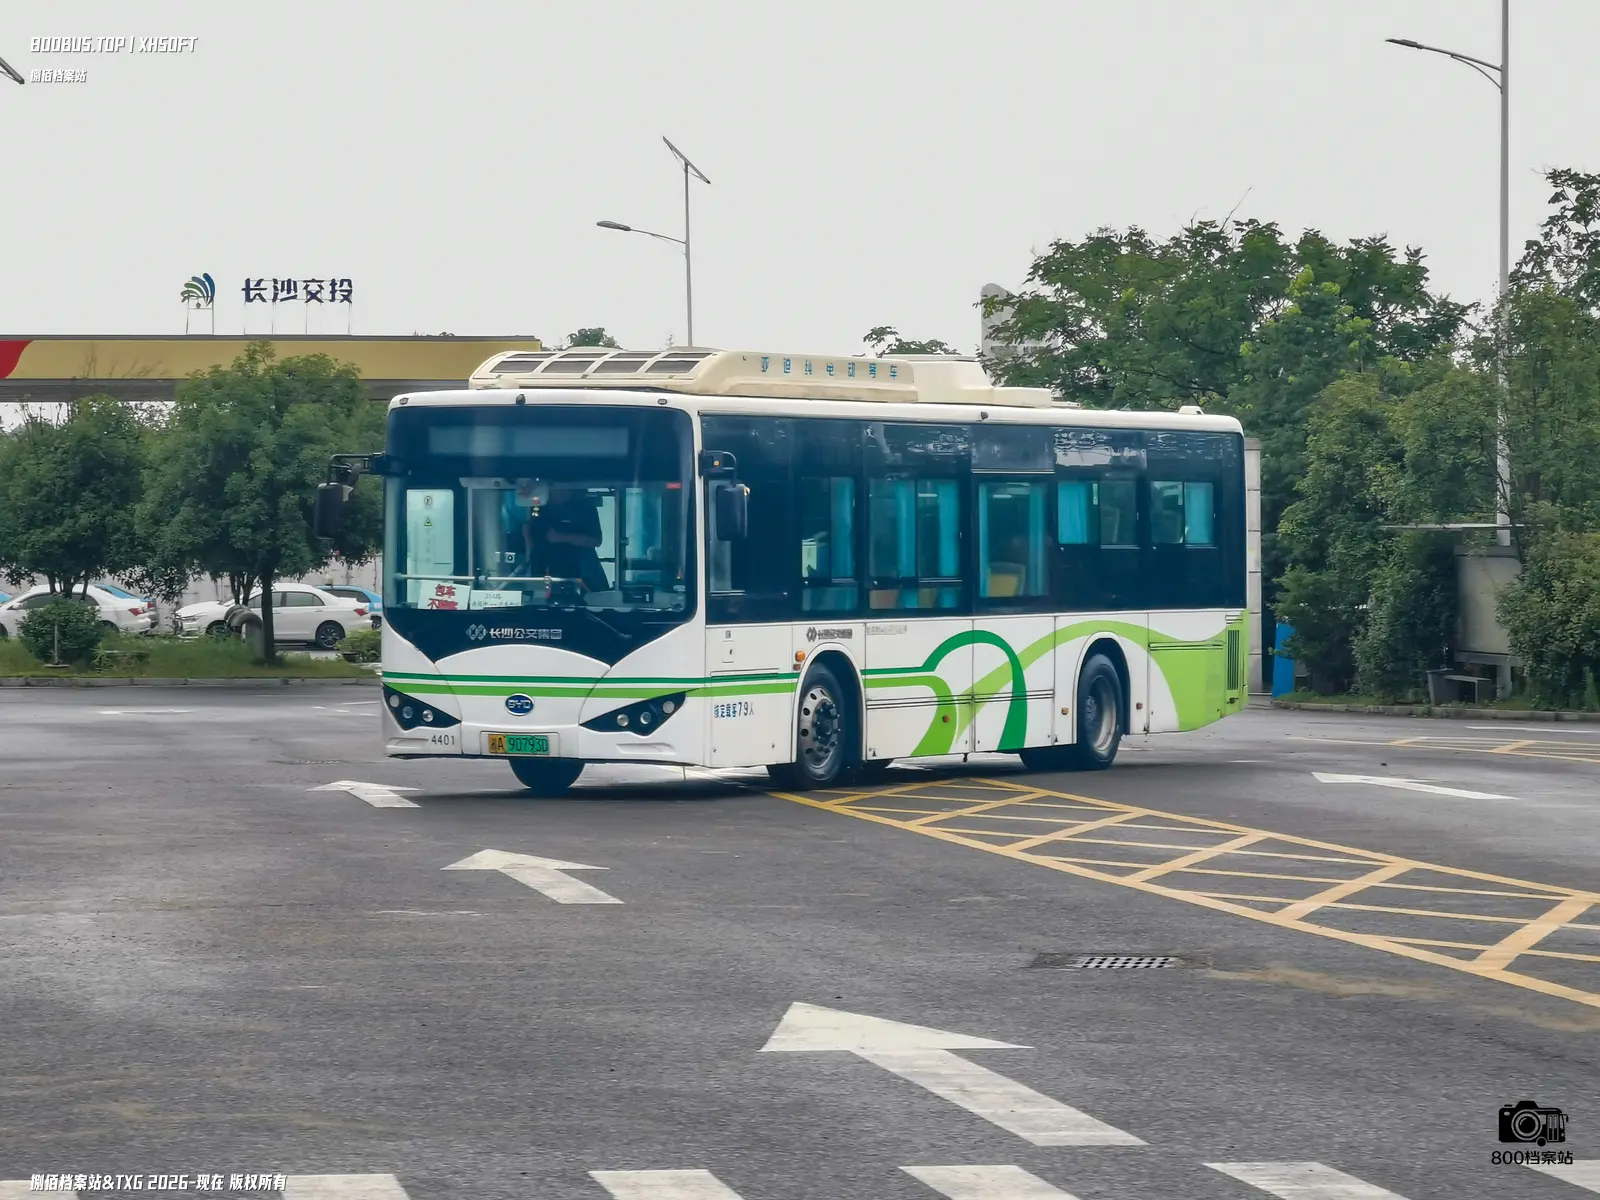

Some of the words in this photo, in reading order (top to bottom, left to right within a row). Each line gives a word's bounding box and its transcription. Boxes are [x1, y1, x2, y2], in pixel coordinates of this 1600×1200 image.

[241, 277, 353, 304] 长沙交投
[742, 355, 898, 379] 亚迪纯电动客车
[508, 699, 532, 709] BYD
[431, 735, 455, 746] 4401
